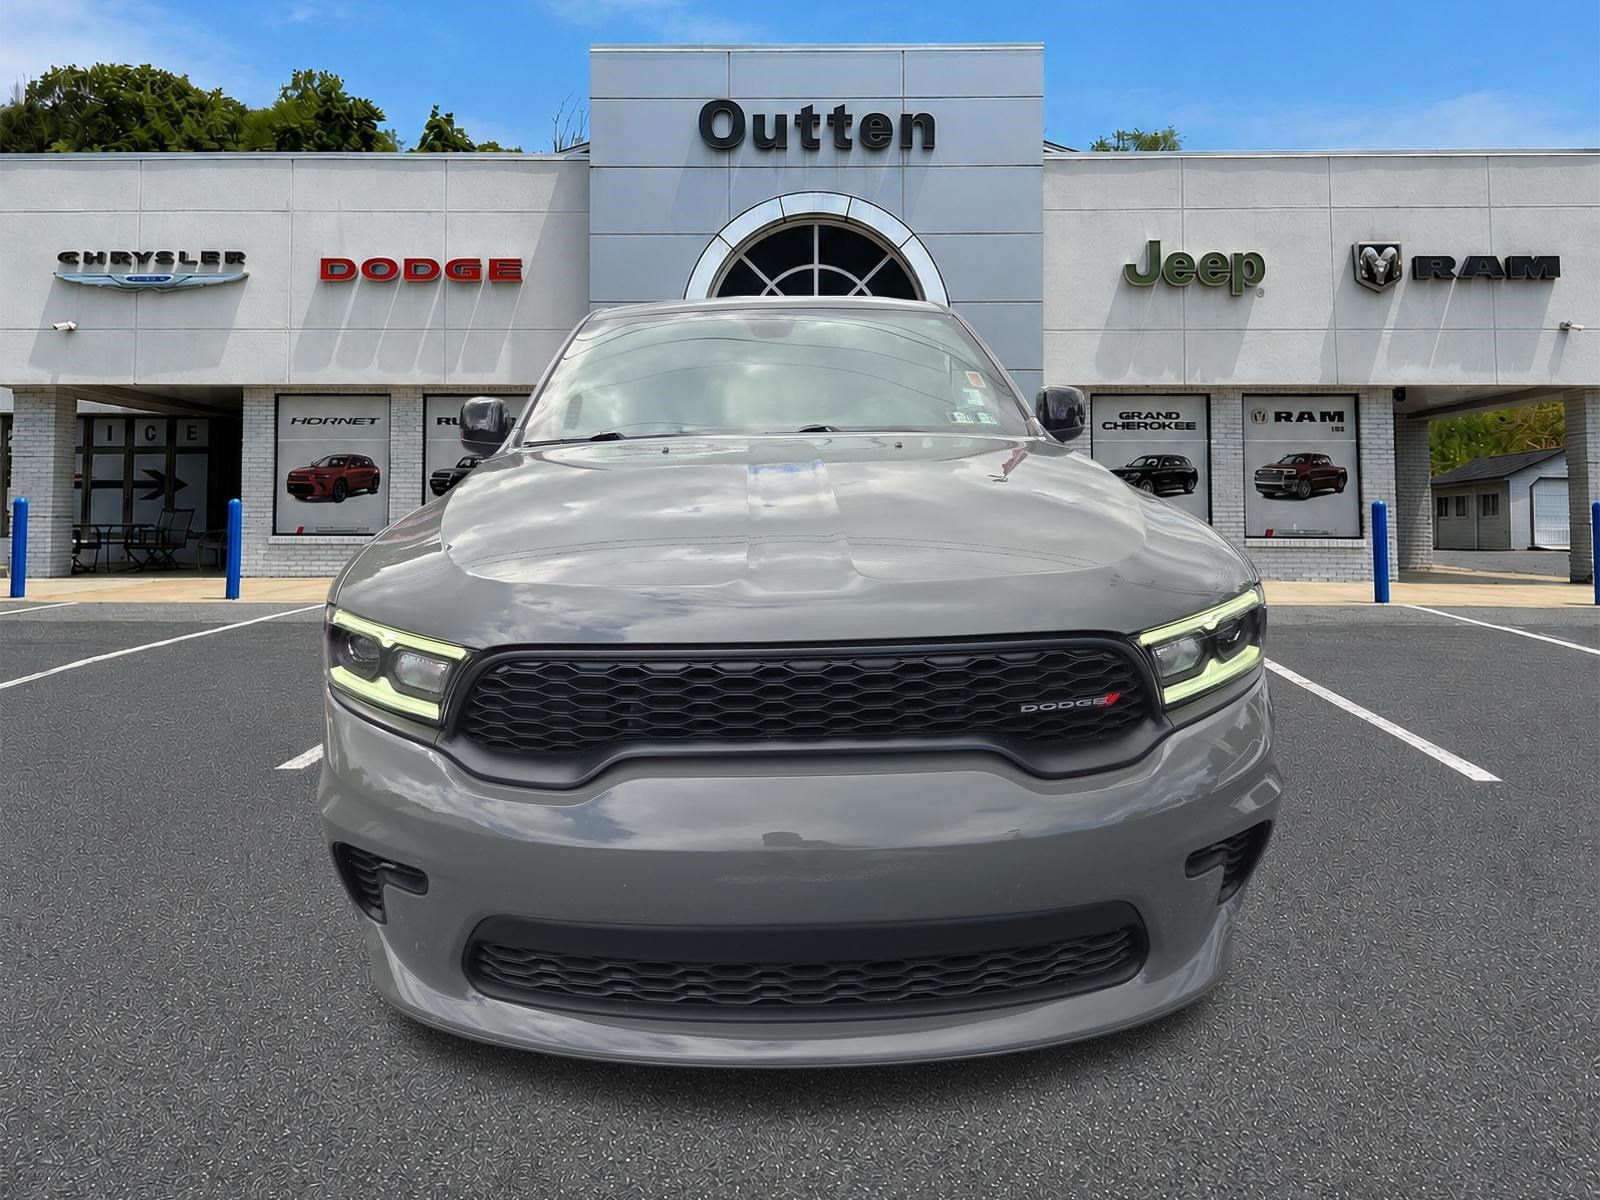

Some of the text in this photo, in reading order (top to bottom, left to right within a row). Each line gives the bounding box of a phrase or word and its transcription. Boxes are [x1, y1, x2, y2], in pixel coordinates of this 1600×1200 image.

[699, 99, 935, 150] Outten
[57, 251, 246, 265] CHRYSLER
[320, 257, 523, 283] DODGE
[1123, 240, 1265, 296] Jeep
[1411, 255, 1562, 281] RAM
[291, 416, 380, 425] HORNET
[1118, 411, 1181, 420] GRAND
[1274, 411, 1345, 423] RAM
[1101, 421, 1197, 430] CHEROKEE
[1020, 697, 1108, 713] DODGE
